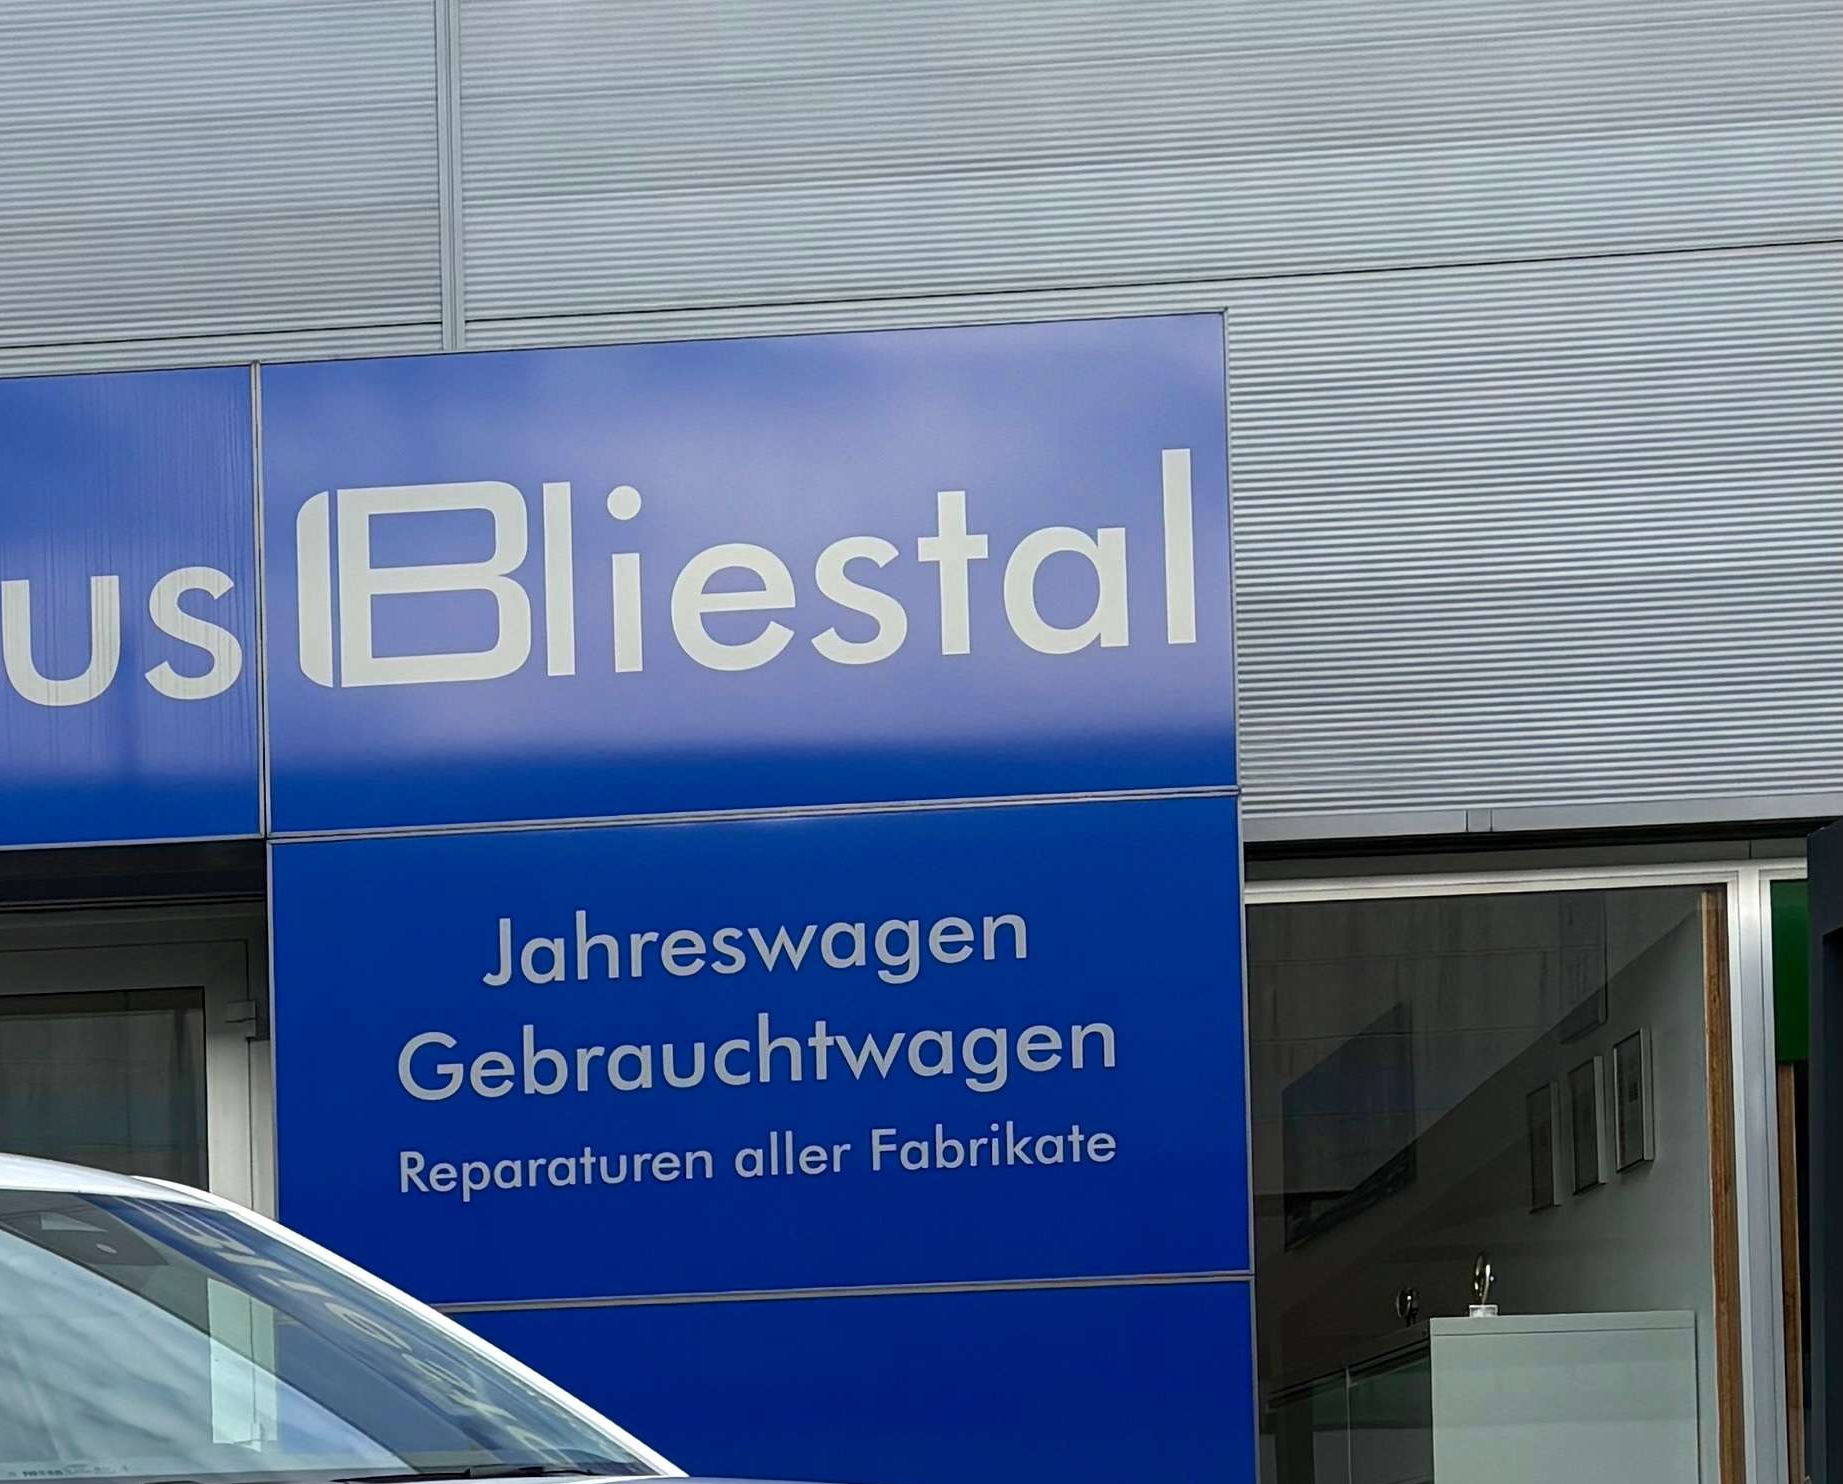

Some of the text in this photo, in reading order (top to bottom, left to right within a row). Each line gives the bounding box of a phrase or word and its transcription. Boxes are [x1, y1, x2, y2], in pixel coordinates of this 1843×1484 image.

[296, 448, 1198, 688] Bliestal
[483, 910, 1028, 986] Jahreswagen
[397, 1012, 1116, 1101] Gebrauchtwagen
[399, 1120, 1117, 1203] Reparaturen aller Fabrikate
